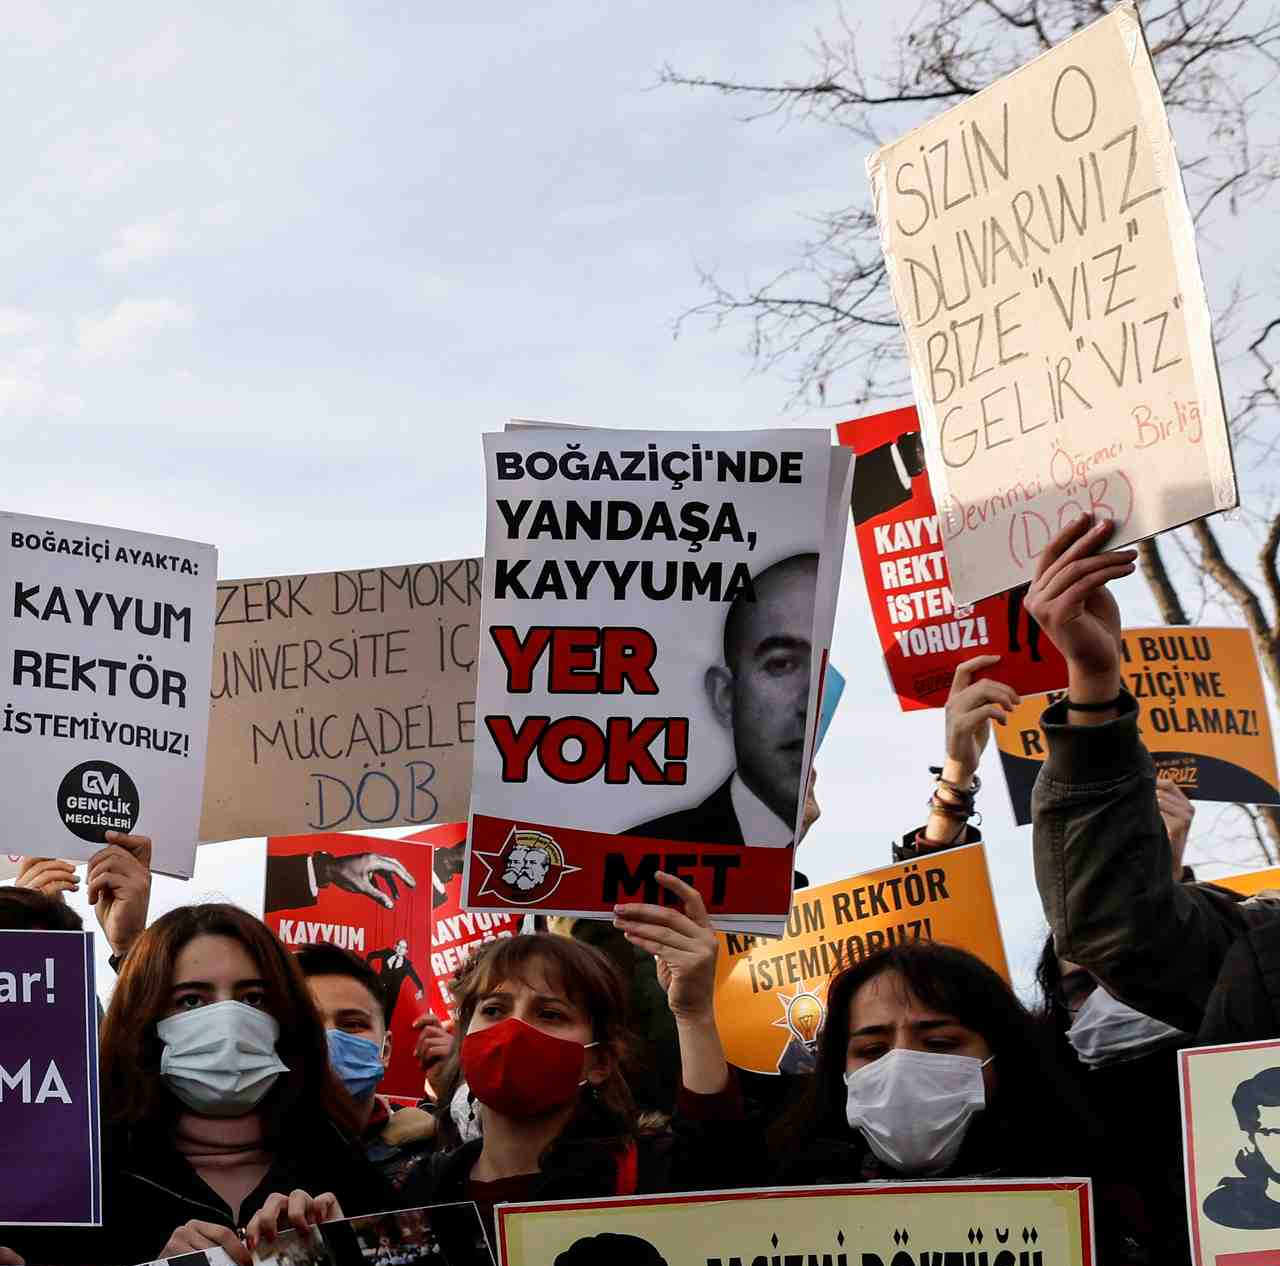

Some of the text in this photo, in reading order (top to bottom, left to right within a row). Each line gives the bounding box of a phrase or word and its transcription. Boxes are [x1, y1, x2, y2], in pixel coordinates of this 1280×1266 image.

[895, 64, 1097, 238] SİZİN O
[903, 125, 1163, 328] DUVARINIZ
[940, 356, 1092, 470] GELİR
[495, 443, 805, 490] BOĞAZİÇİ'NDE
[495, 499, 758, 552] YANDAŞA,
[11, 530, 199, 576] BOĞAZİÇİ AYAKTA:
[494, 560, 757, 602] KAYYUMA
[13, 581, 192, 642] KAYYUM
[894, 616, 990, 657] YORUZ!
[489, 625, 660, 695] YER
[1139, 636, 1212, 661] BULU
[12, 649, 188, 709] REKTÖR
[2, 703, 190, 757] İSTEMİYORUZ!
[1151, 707, 1260, 736] OLAMAZ!
[484, 715, 690, 785] YOK!
[65, 813, 132, 830] MECLİSLERİ
[66, 795, 131, 816] GENÇLİK
[308, 762, 439, 830] DÖB
[832, 864, 950, 924] REKTÖR
[278, 919, 365, 951] KAYYUM
